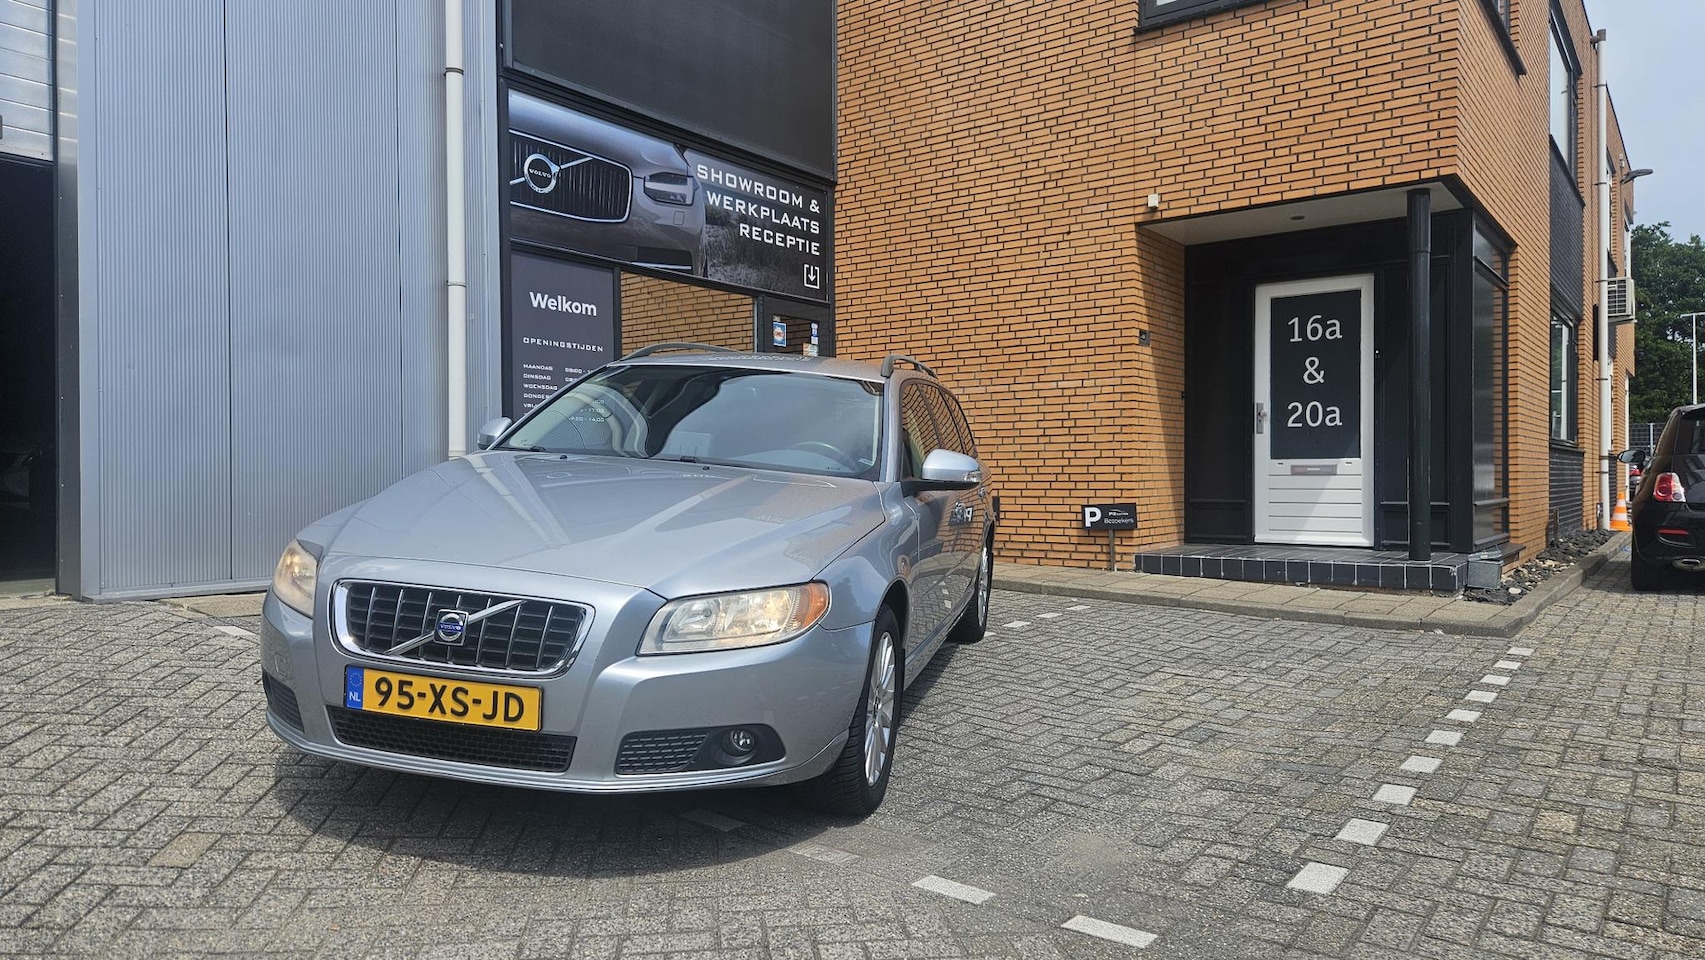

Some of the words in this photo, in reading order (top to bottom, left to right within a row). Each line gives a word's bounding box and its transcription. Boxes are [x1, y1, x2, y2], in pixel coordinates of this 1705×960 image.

[529, 168, 552, 179] VOLVO
[697, 164, 803, 209] SHOWROOM
[809, 199, 820, 214] &
[706, 190, 820, 235] WERKPLAATS
[739, 223, 820, 256] RECEPTIE
[529, 291, 597, 317] Welkom
[1287, 315, 1343, 342] 16a
[523, 337, 603, 352] OPENINGSTIJDEN
[523, 363, 553, 371] MAANDAG
[523, 373, 551, 381] DINSDAG
[1302, 356, 1325, 384] &
[523, 383, 558, 391] WOENSDAG
[1287, 401, 1343, 428] 20a
[1084, 507, 1102, 527] P
[349, 691, 361, 702] NL
[374, 677, 525, 722] 95-XS-JD
